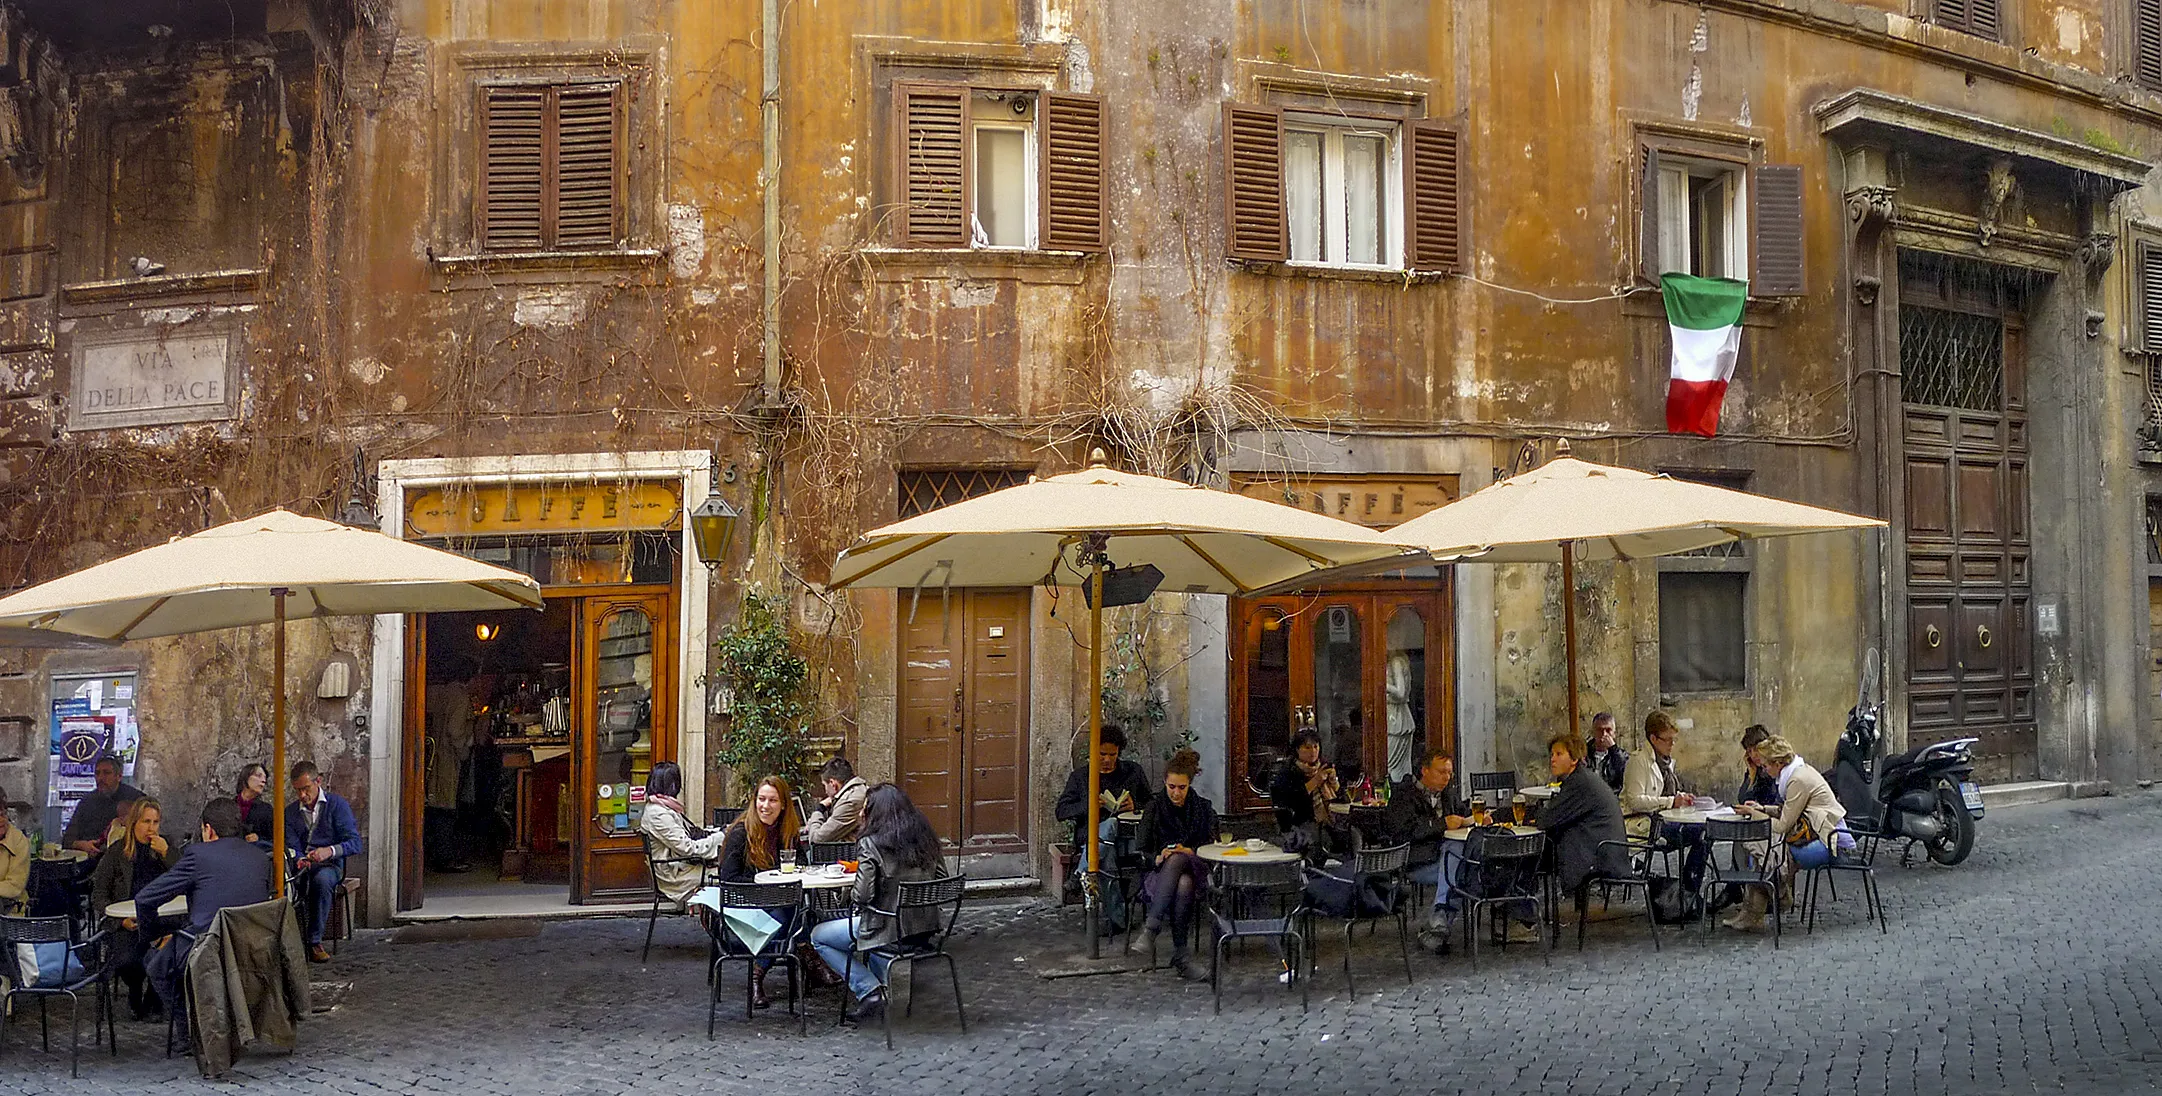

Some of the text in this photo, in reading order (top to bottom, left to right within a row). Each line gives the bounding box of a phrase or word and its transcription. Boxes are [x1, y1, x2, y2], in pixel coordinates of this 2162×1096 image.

[136, 352, 174, 370] VIA
[87, 380, 219, 409] DELLA PACE
[1286, 486, 1404, 514] AFFÈ
